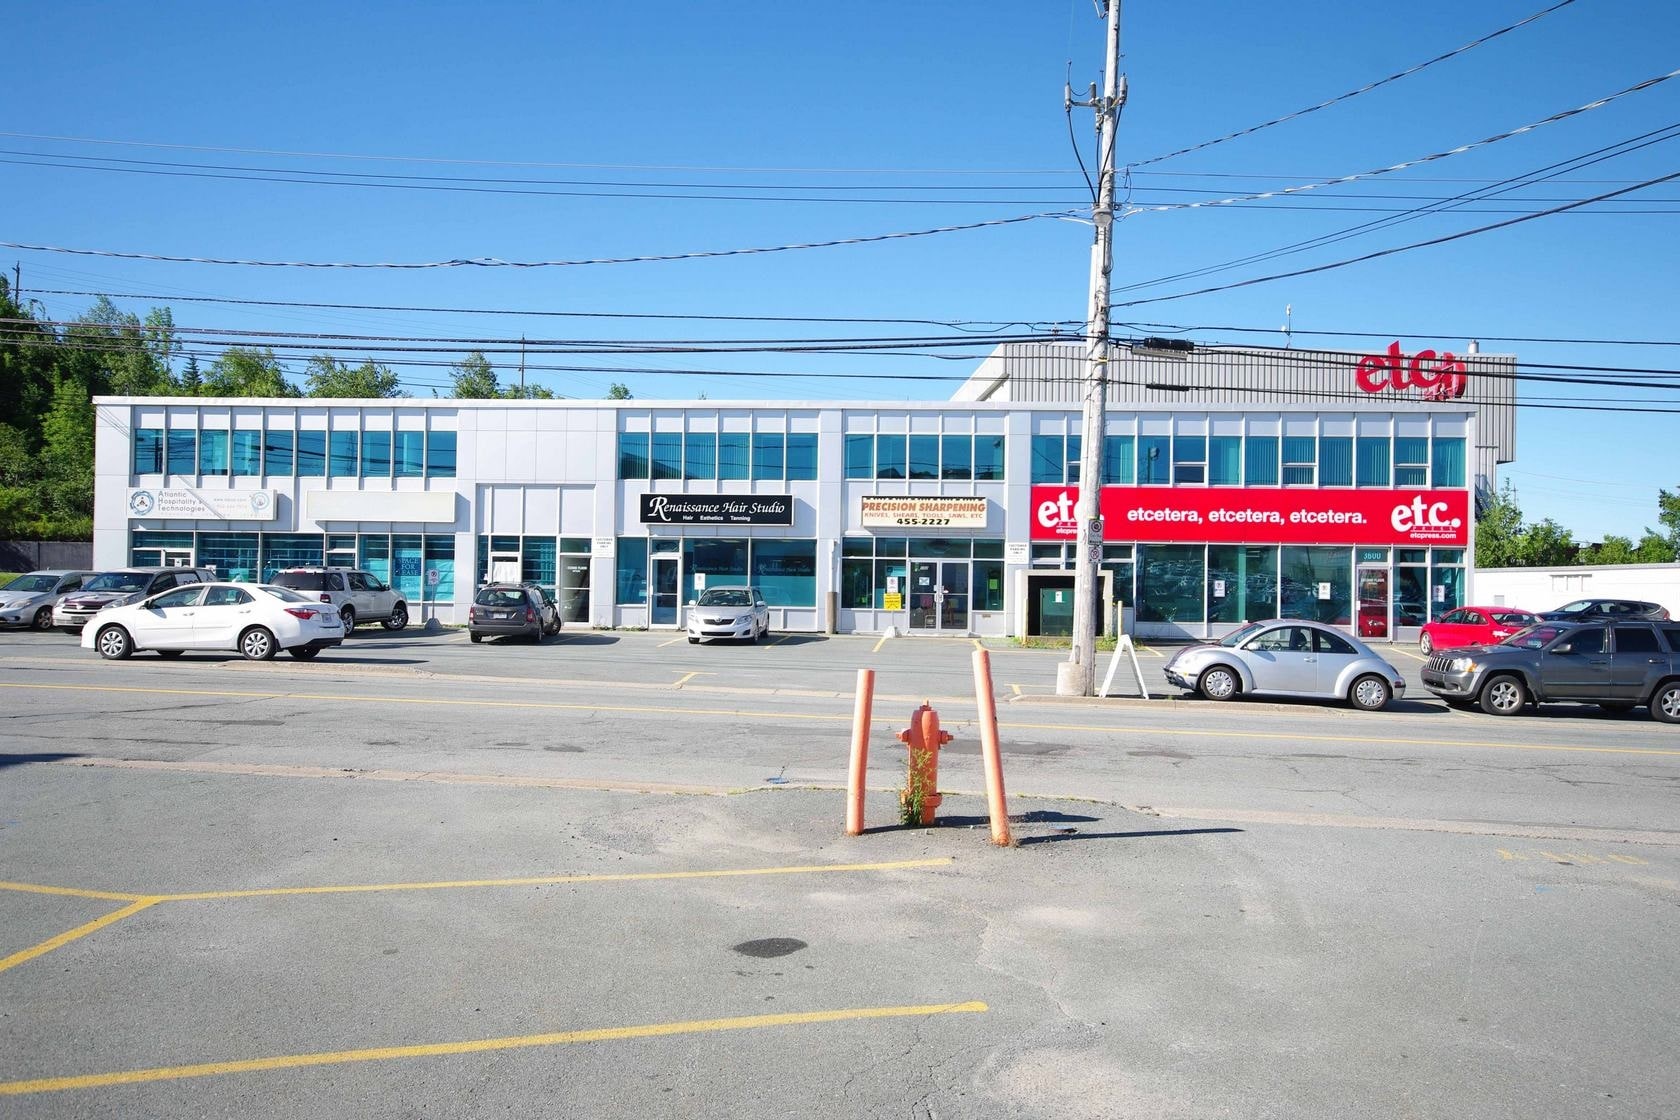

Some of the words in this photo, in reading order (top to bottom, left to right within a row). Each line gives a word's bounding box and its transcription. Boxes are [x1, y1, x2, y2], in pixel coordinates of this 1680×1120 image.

[158, 490, 187, 498] Atlantic
[158, 505, 205, 513] Technologies
[648, 496, 719, 522] Renaissance
[722, 502, 748, 513] Hair
[749, 501, 785, 514] Studio
[862, 502, 917, 512] PRECISION
[919, 503, 986, 512] SHARPENING
[1127, 507, 1203, 525] etcetera,
[1208, 508, 1285, 526] etcetera,
[1289, 508, 1367, 524] etcetera.
[1390, 494, 1461, 533] etc.
[1409, 532, 1457, 540] etcpress.com
